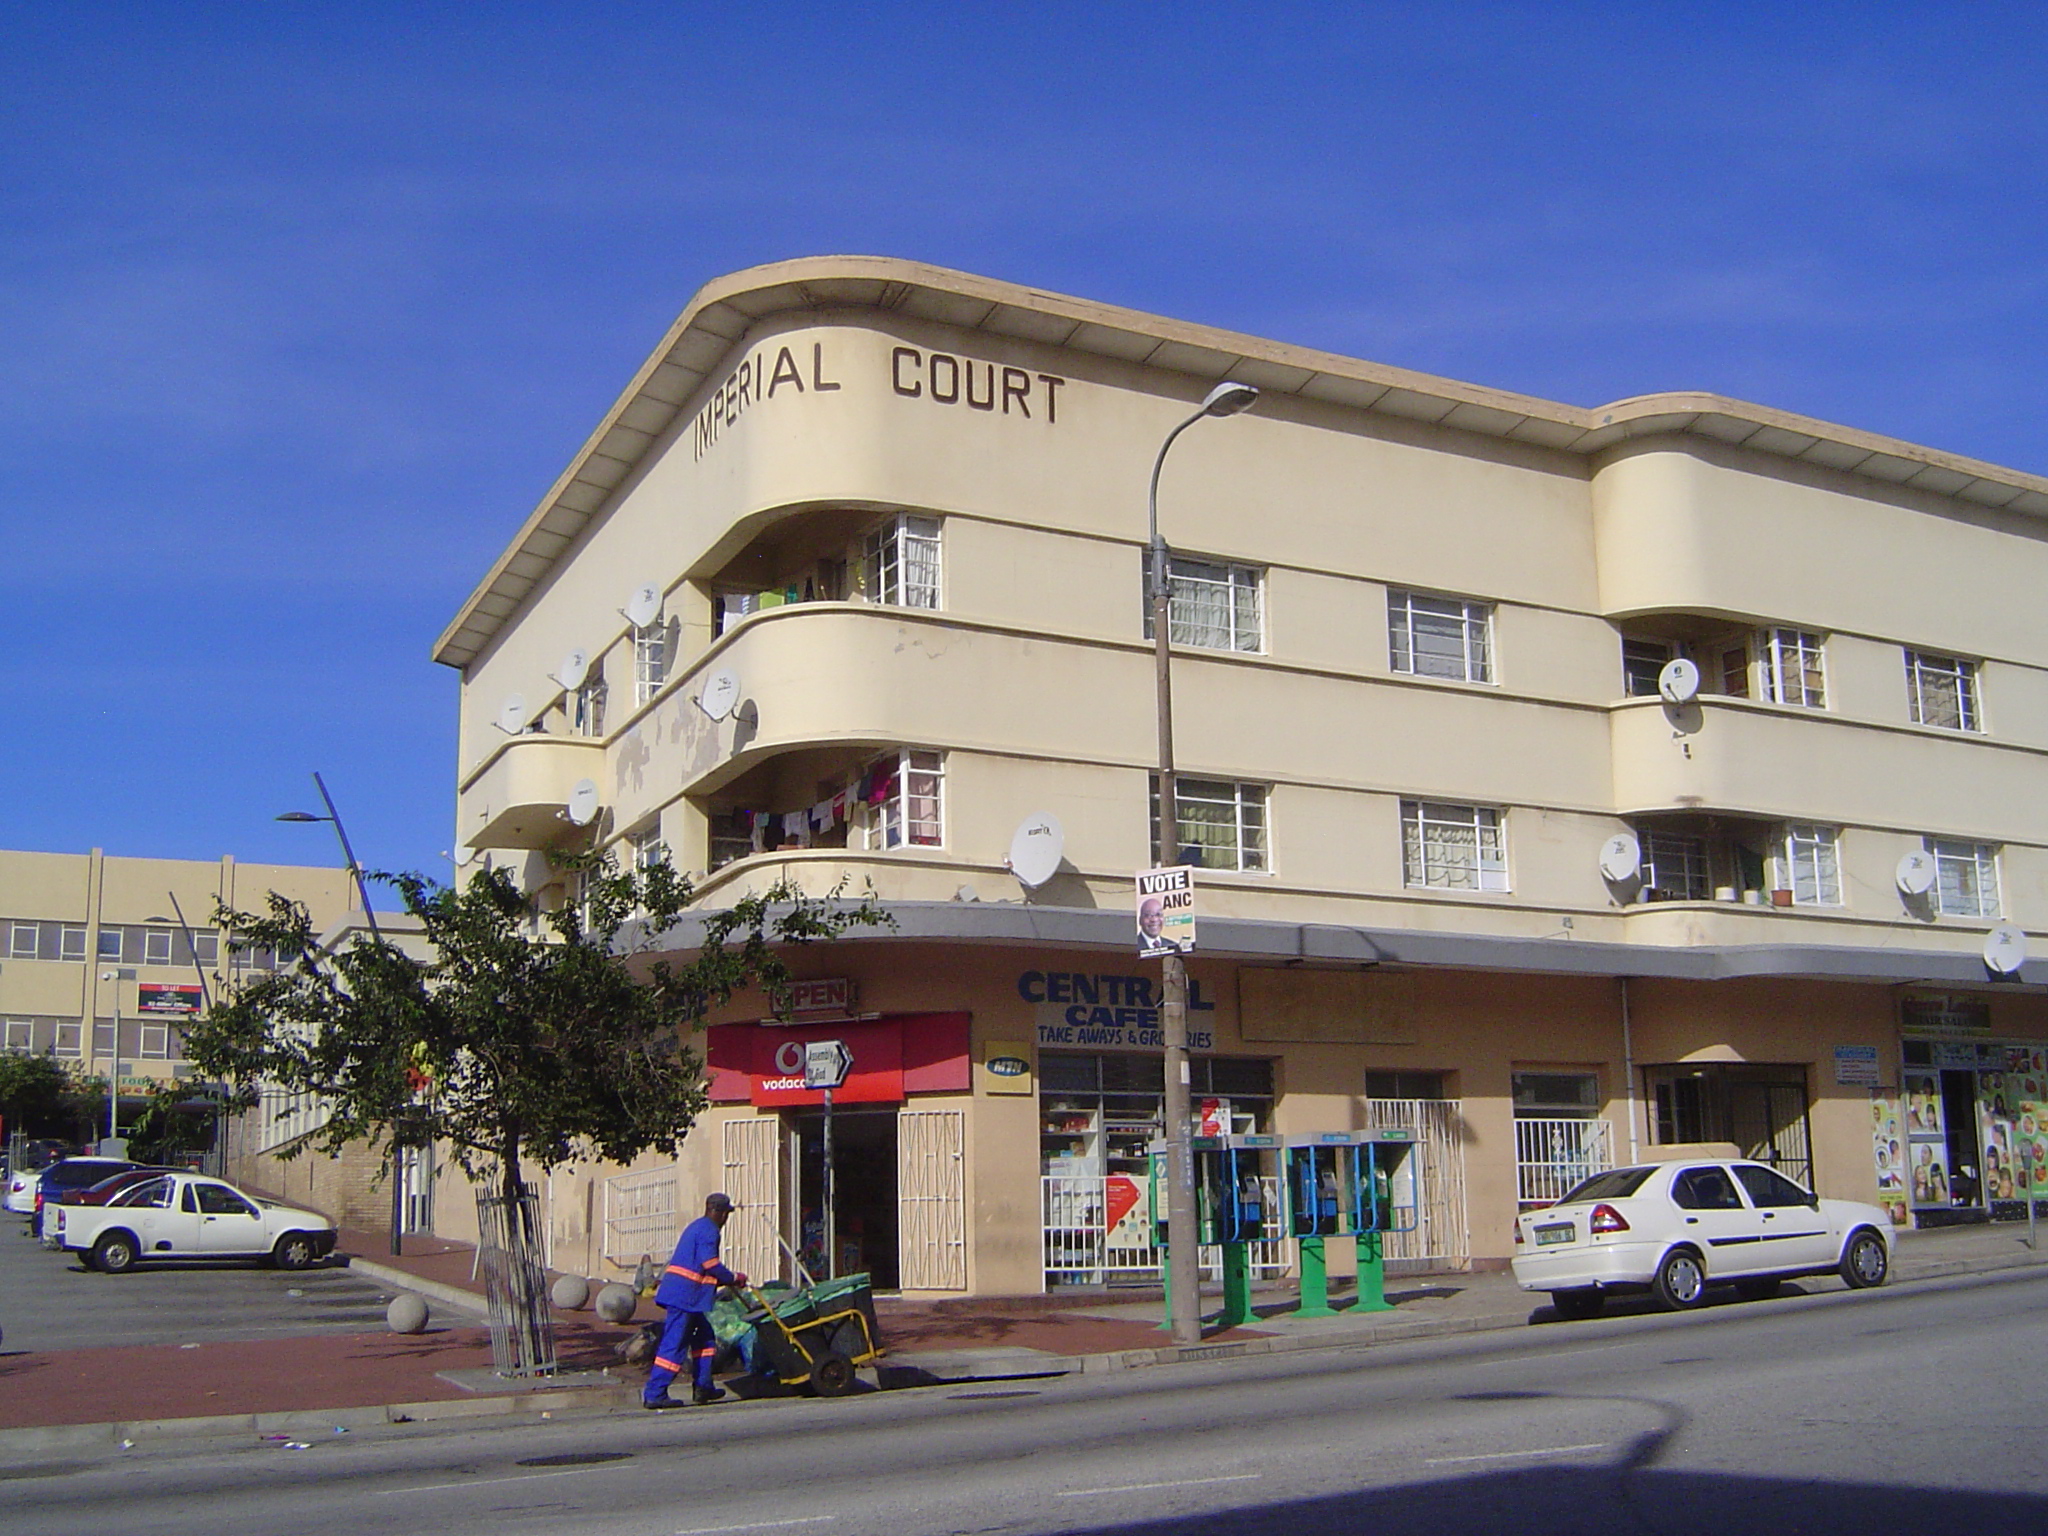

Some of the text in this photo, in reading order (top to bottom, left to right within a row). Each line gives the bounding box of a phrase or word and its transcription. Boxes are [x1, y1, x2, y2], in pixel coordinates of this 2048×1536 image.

[694, 342, 1065, 463] IMPERIAL COURT
[1143, 871, 1186, 894] VOTE
[1163, 892, 1192, 910] ANC
[774, 983, 845, 1009] PEN
[1018, 970, 1214, 1011] CENTRL
[1065, 1005, 1159, 1029] CAFE
[1038, 1025, 1212, 1048] TAKE AWAYS & GRORIES
[762, 1077, 806, 1090] vodaco
